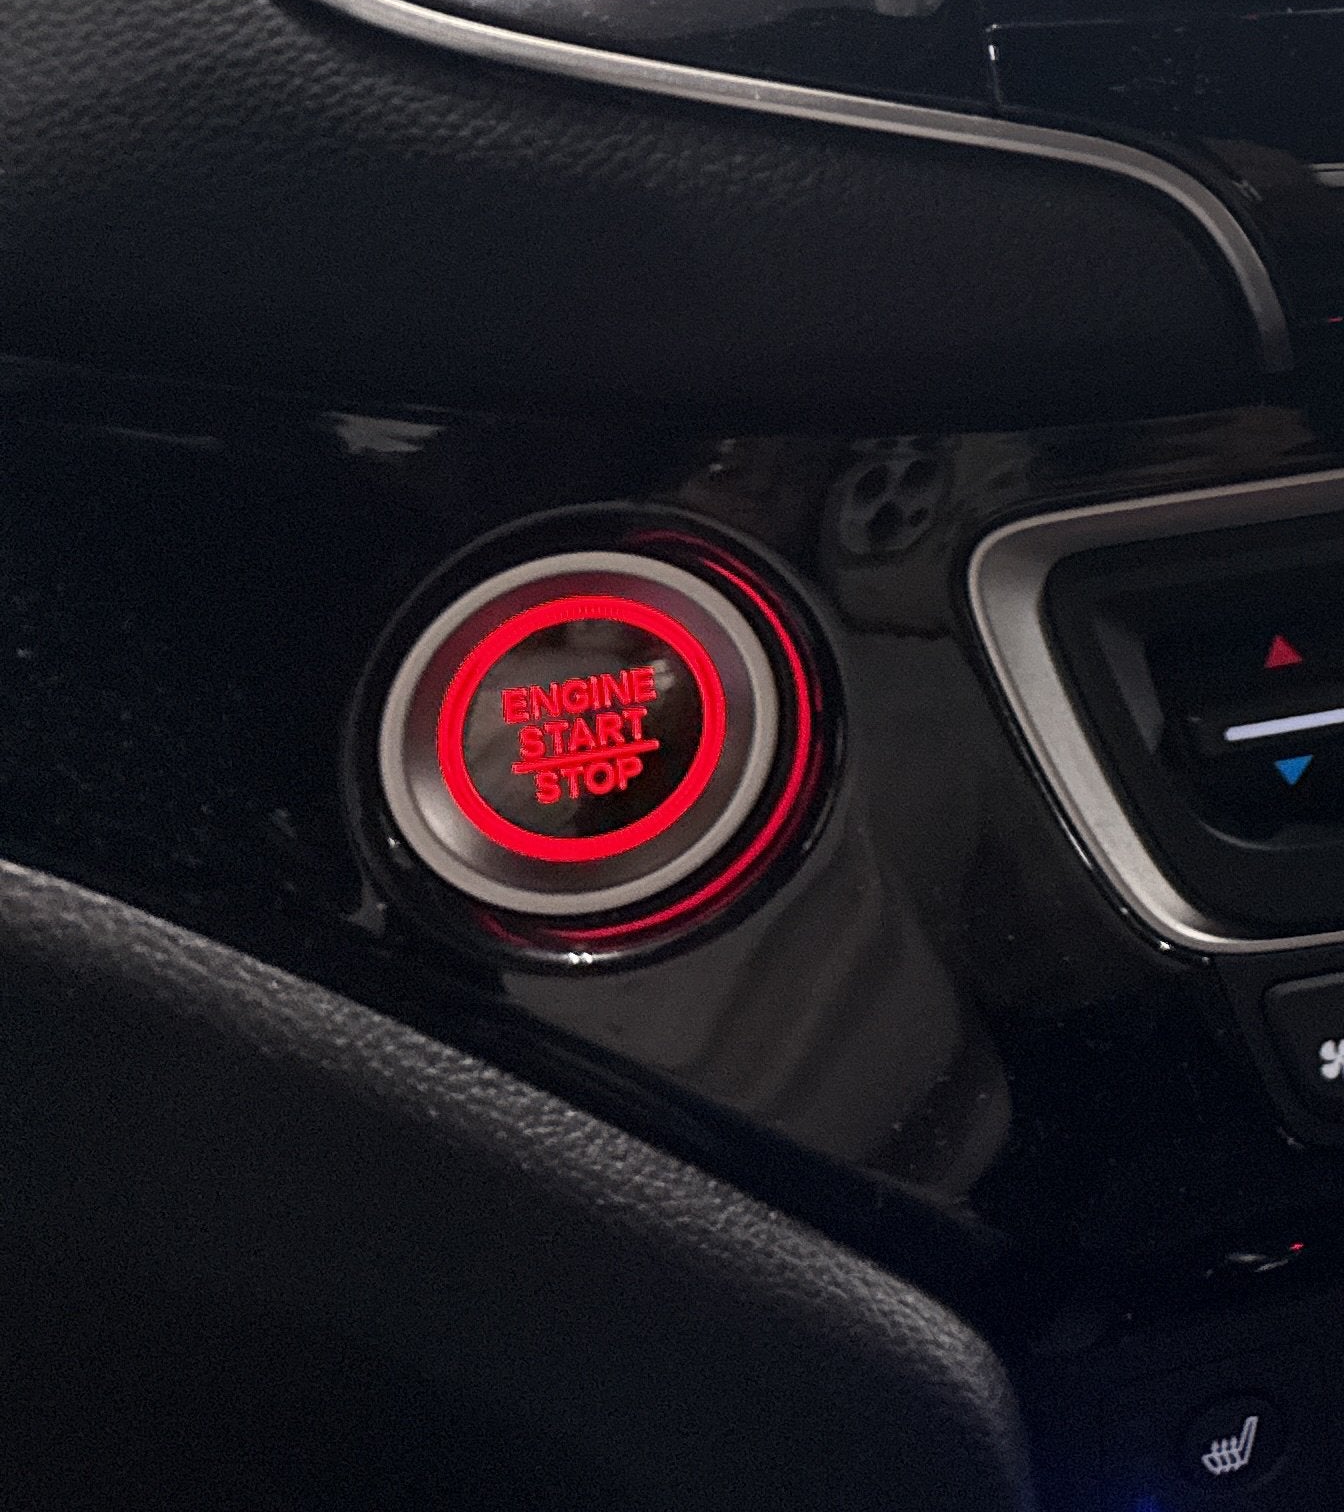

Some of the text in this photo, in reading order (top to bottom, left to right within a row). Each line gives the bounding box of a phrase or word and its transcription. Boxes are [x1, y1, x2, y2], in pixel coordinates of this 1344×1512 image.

[502, 666, 658, 724] ENGINE
[519, 707, 648, 761] START
[536, 756, 643, 804] STOP
